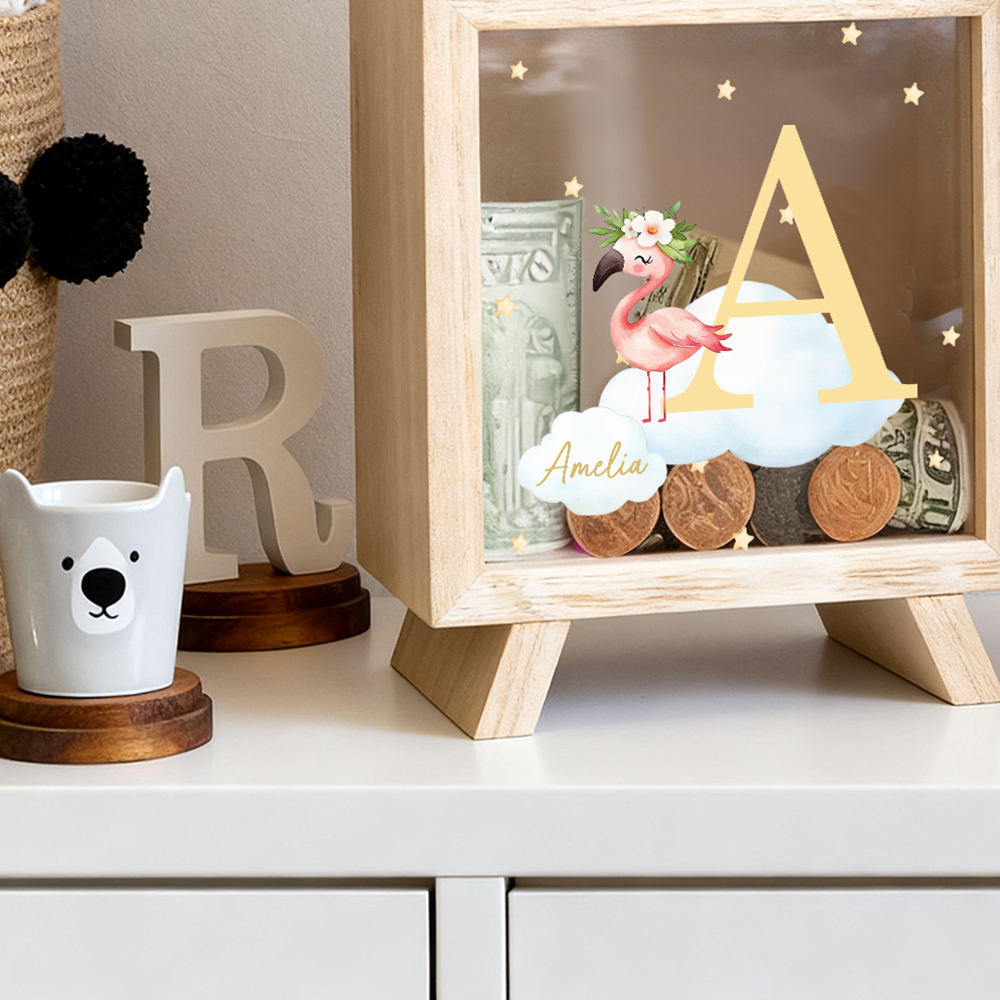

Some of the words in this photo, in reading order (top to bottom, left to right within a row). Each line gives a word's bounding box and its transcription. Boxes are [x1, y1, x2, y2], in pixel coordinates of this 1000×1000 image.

[660, 125, 918, 414] A
[114, 309, 355, 584] R
[535, 440, 649, 487] Amelia
